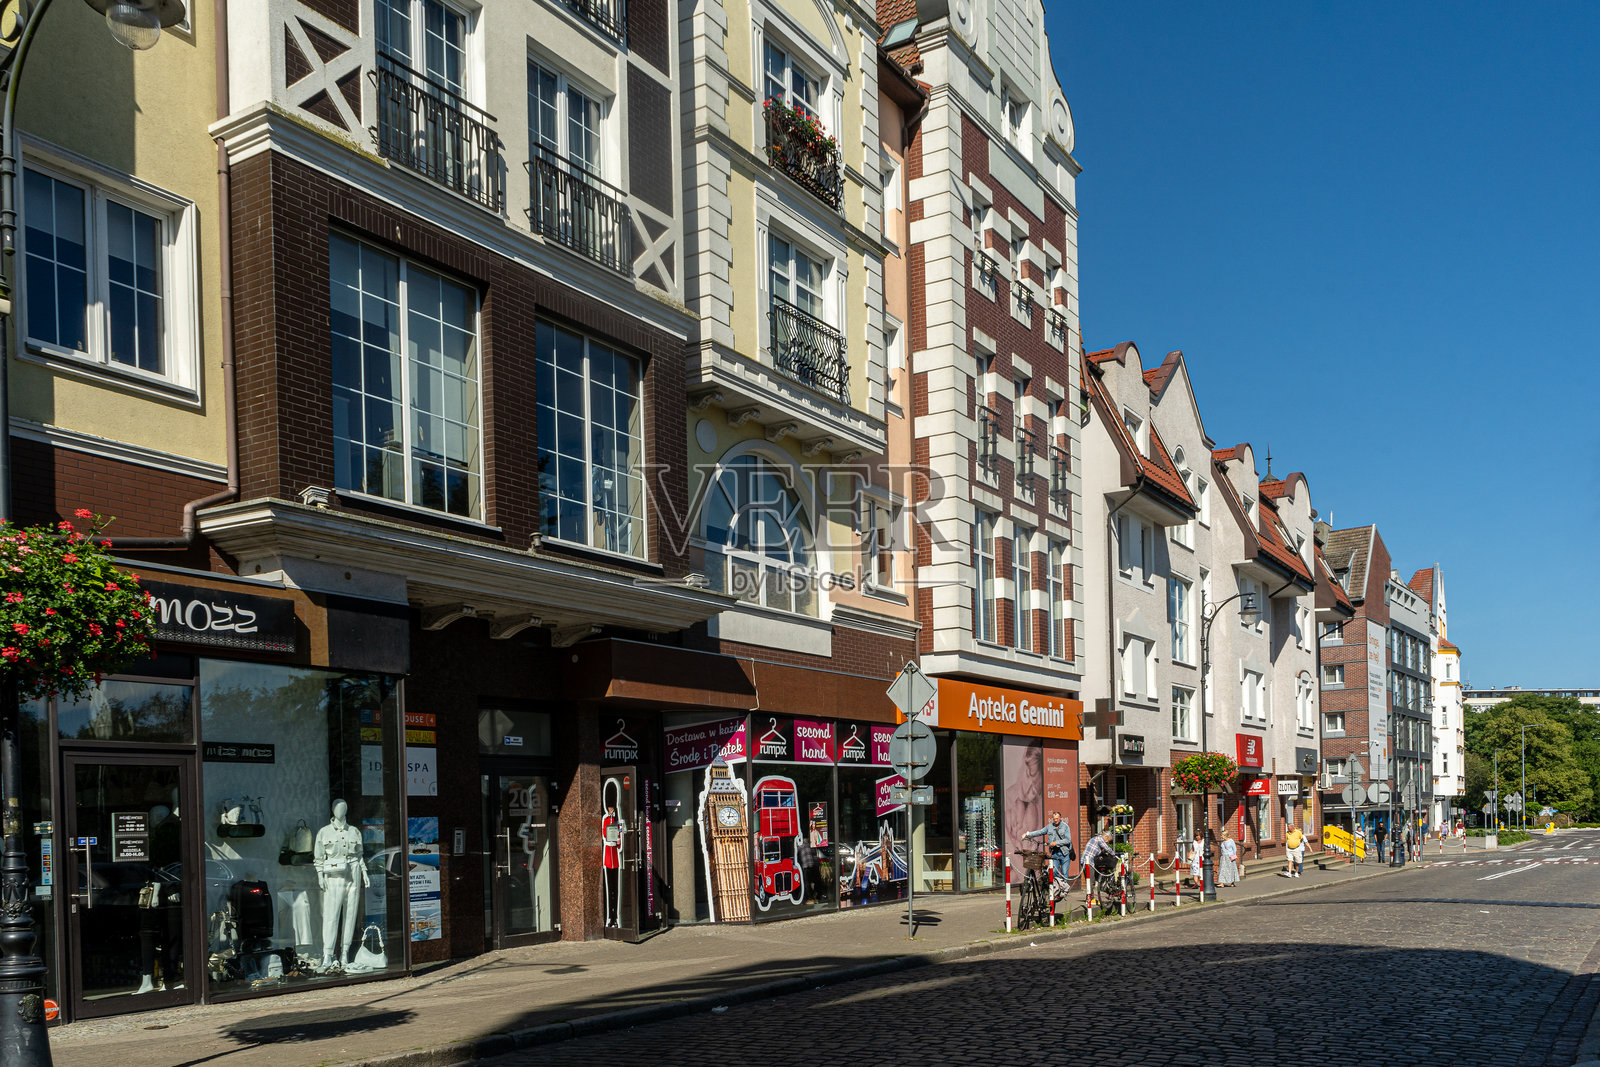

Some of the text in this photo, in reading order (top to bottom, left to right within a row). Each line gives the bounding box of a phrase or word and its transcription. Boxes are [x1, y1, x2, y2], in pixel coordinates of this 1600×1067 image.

[968, 692, 1064, 728] Apteka Gemini
[666, 732, 706, 745] Dostawa
[709, 729, 716, 737] w
[796, 722, 831, 739] second
[873, 732, 893, 743] seco
[604, 749, 638, 763] rumpix
[670, 738, 743, 766] Środę i Piątek
[759, 744, 787, 758] rumpix
[802, 741, 828, 760] hand
[842, 749, 866, 761] rumpix
[877, 745, 890, 762] ha
[407, 762, 430, 774] SPA
